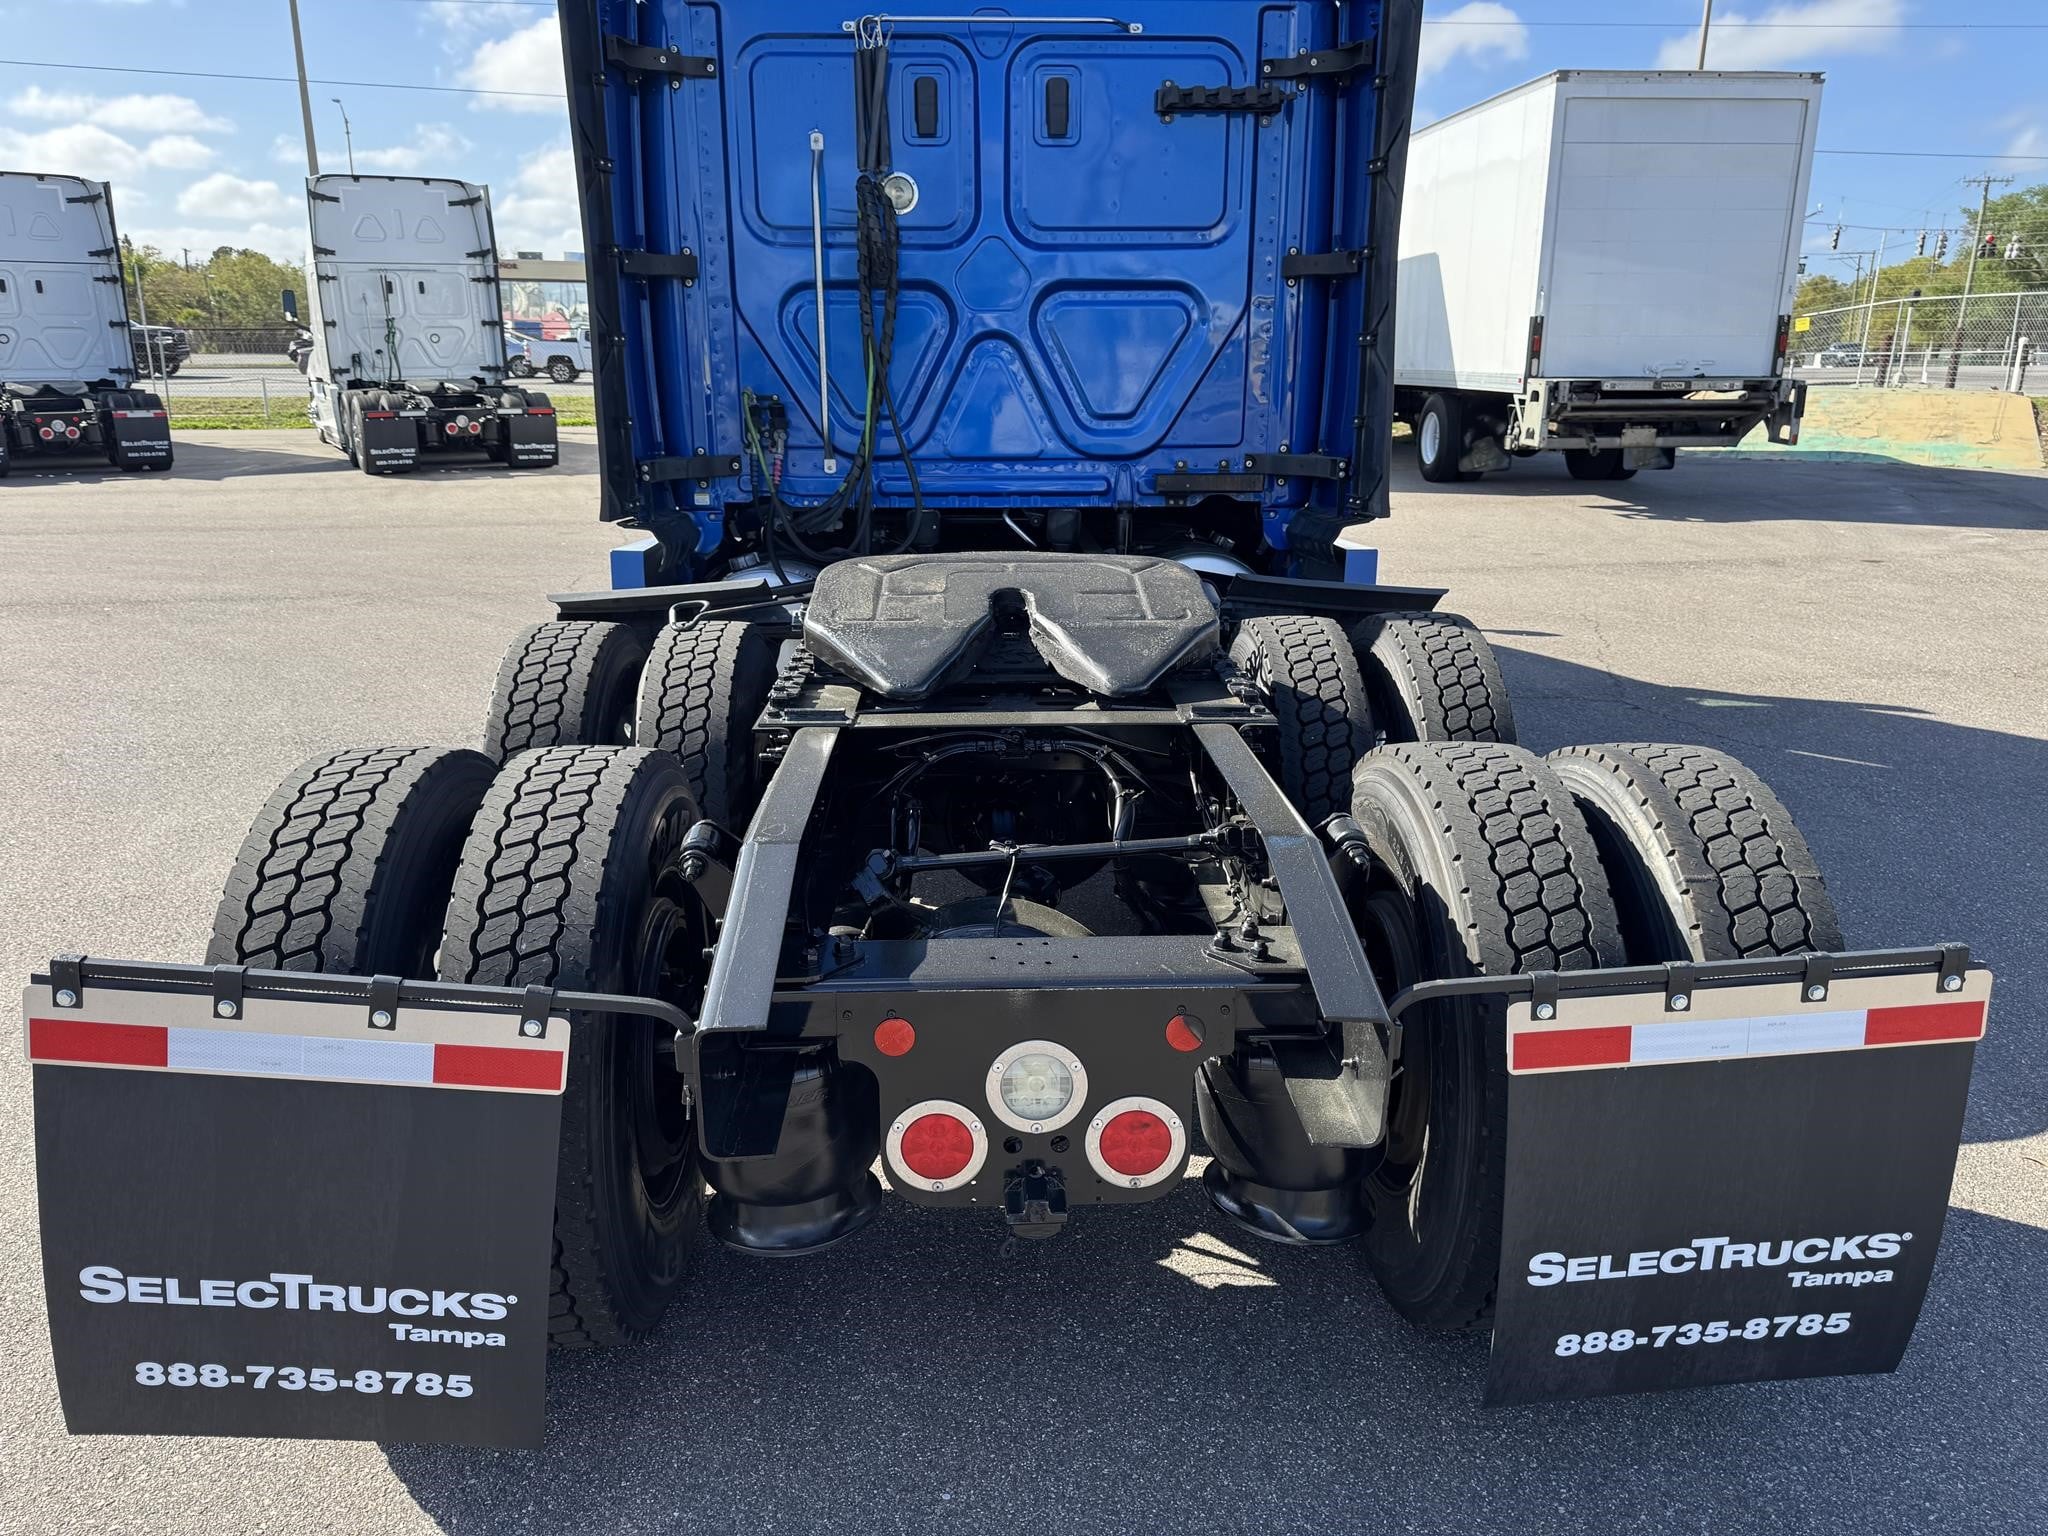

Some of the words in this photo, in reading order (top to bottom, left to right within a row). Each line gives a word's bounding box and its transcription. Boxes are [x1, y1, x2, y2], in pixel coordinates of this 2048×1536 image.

[1787, 1269, 1894, 1289] Tampa
[388, 1323, 507, 1348] Tampa
[1554, 1312, 1852, 1358] 888-735-8785
[134, 1361, 475, 1398] 888-735-8785
